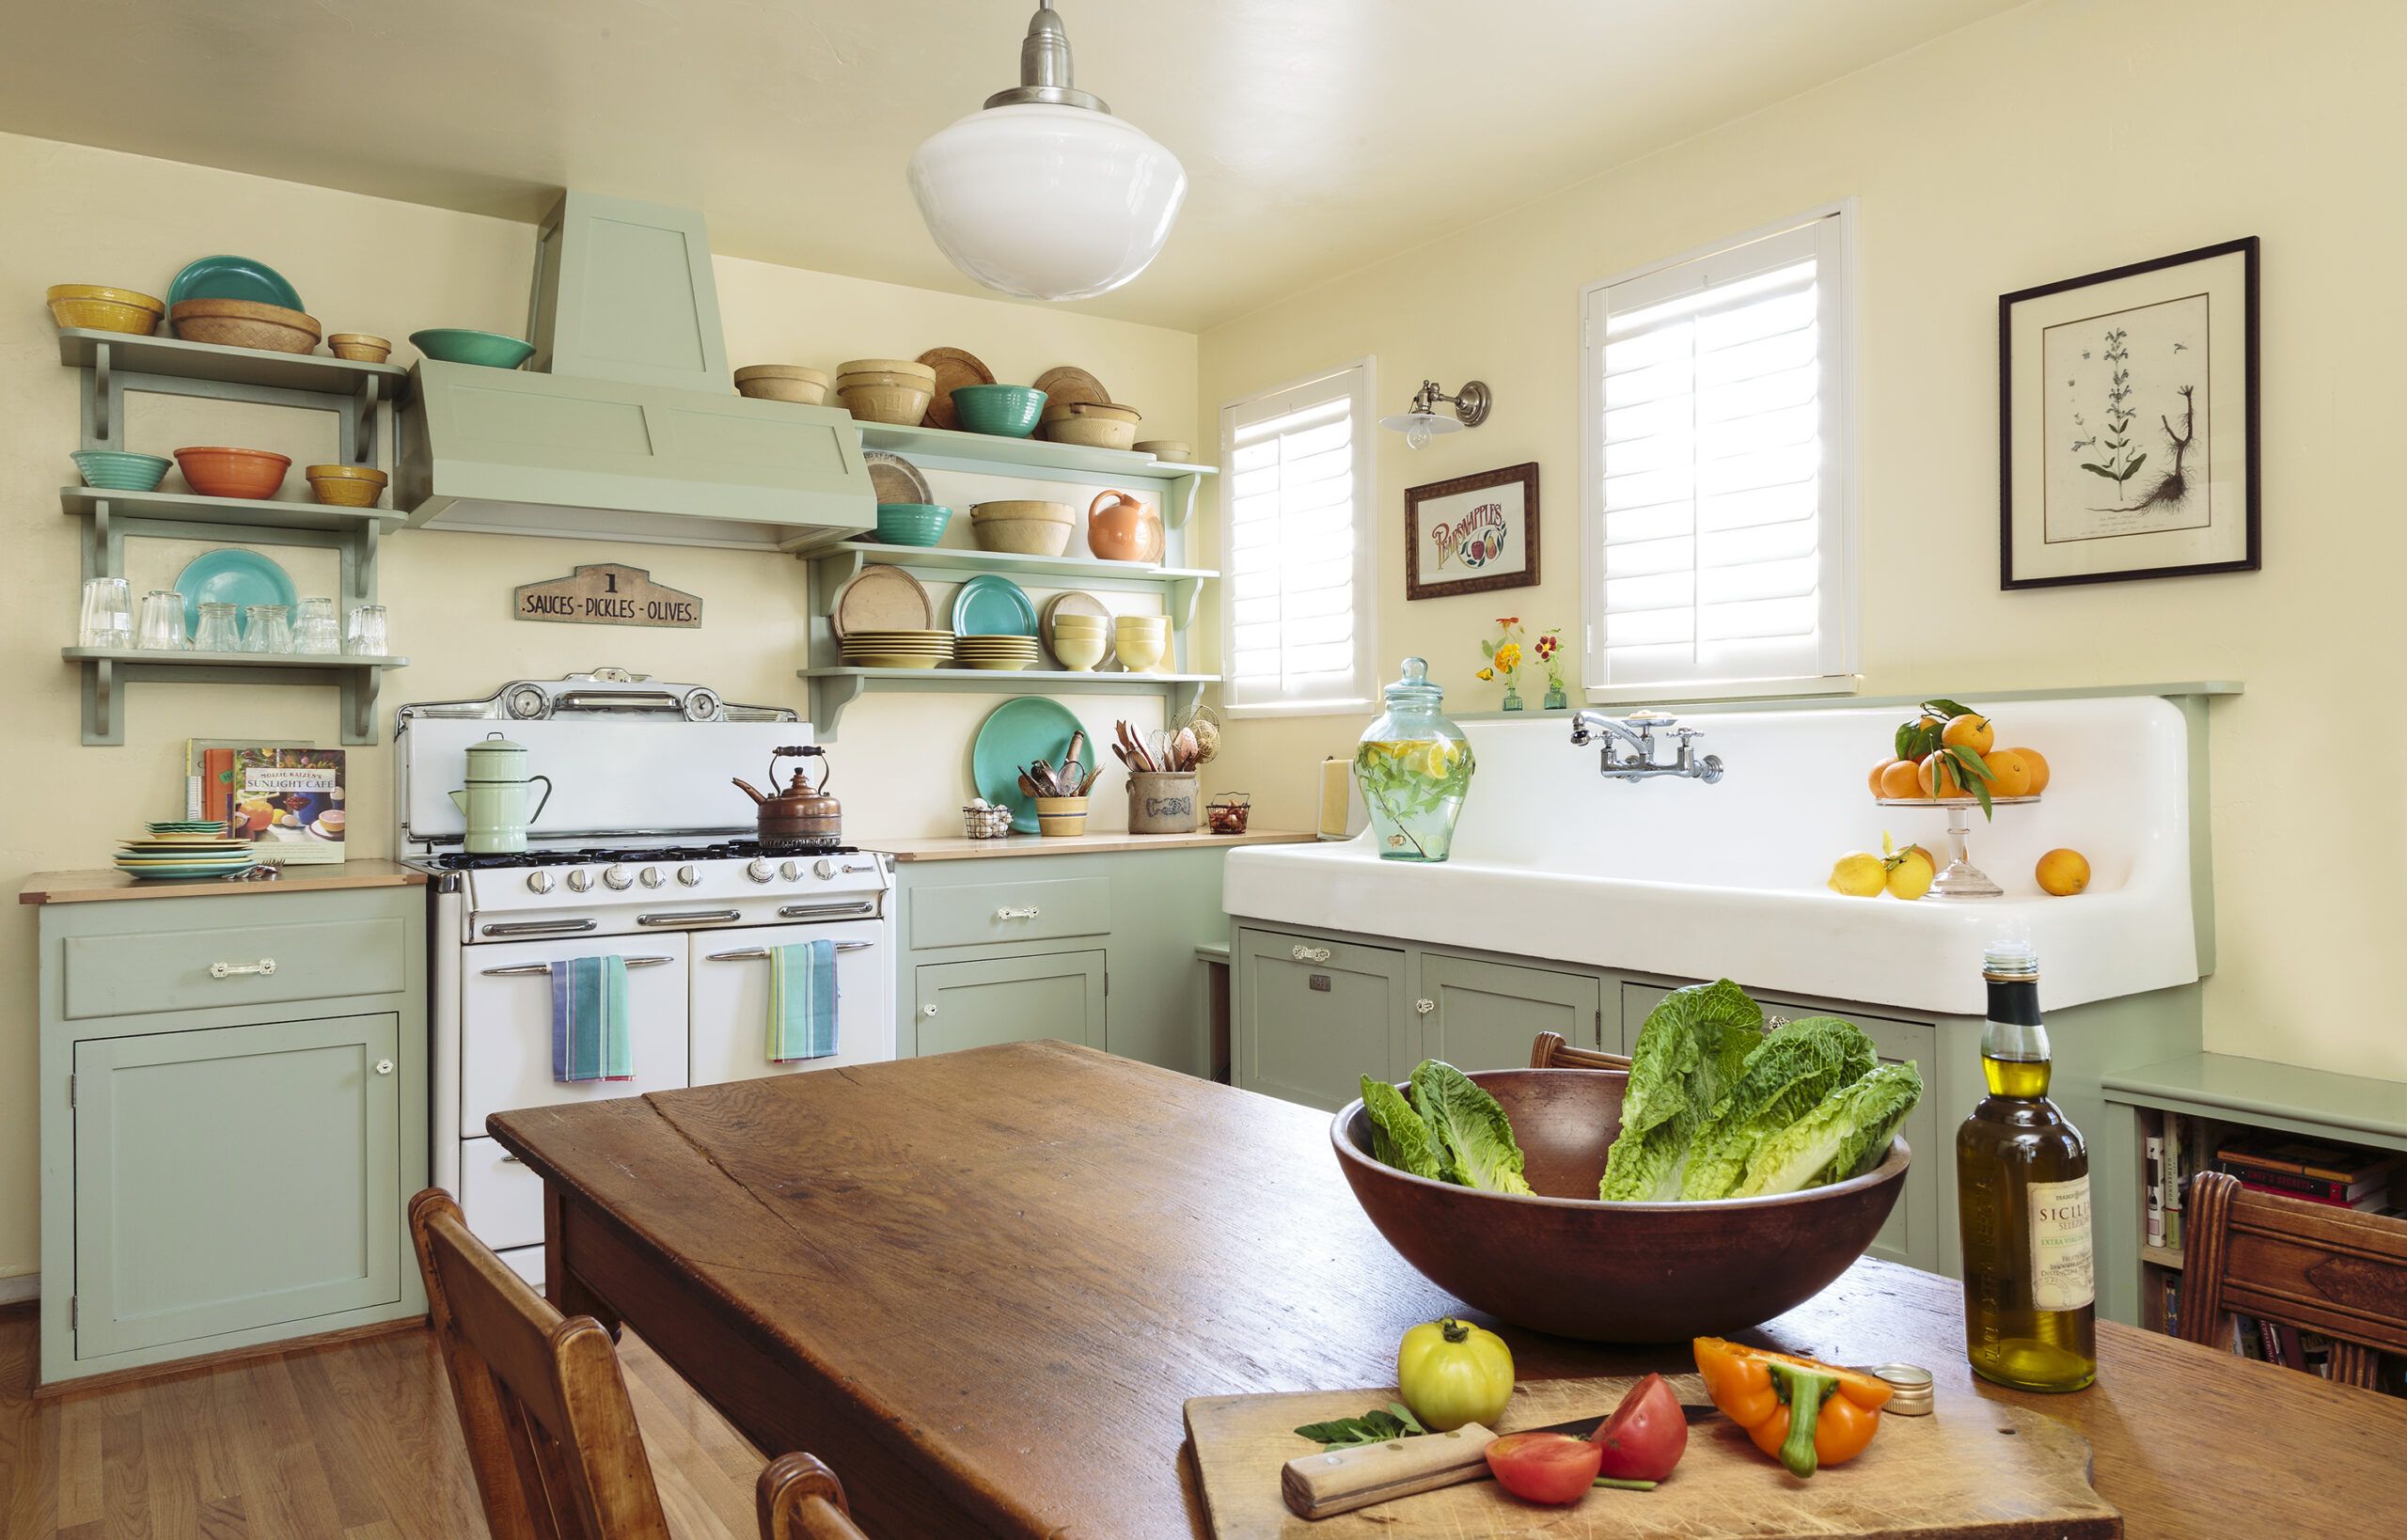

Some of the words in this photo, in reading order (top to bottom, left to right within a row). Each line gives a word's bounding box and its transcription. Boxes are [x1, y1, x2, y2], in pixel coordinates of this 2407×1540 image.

[605, 573, 619, 593] 1
[586, 598, 635, 619] PICKLES
[247, 779, 302, 788] SUNLIGHT
